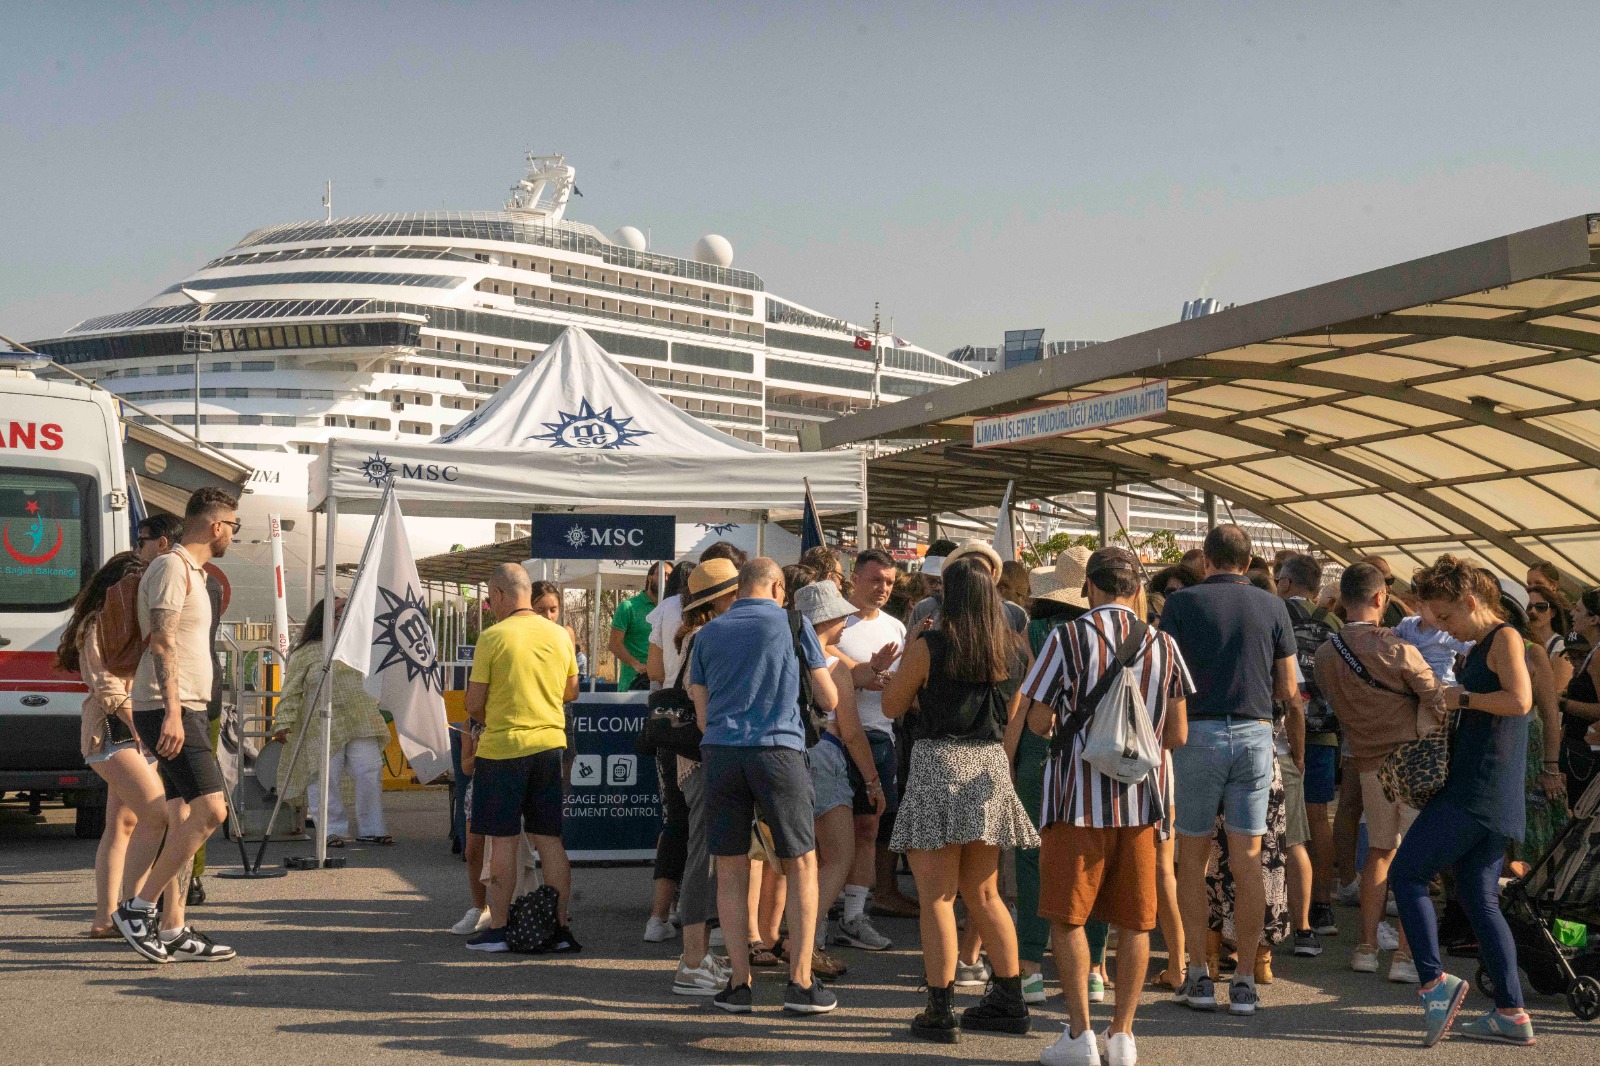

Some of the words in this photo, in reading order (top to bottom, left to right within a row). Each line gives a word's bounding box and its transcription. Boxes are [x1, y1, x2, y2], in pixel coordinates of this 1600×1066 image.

[976, 421, 1004, 444] LİMAN
[1006, 417, 1036, 443] İŞLETME
[1037, 402, 1087, 434] MÜDÜRLÜĞÜ
[1088, 394, 1139, 427] ARAÇLARINA
[1140, 383, 1166, 413] AİTTİR
[401, 463, 459, 482] MSC
[272, 518, 280, 538] STOP
[590, 527, 644, 547] MSC
[280, 633, 289, 653] STOP
[599, 794, 628, 804] DROP
[630, 794, 649, 804] OFF
[651, 794, 660, 804] &
[610, 807, 659, 817] CONTROL
